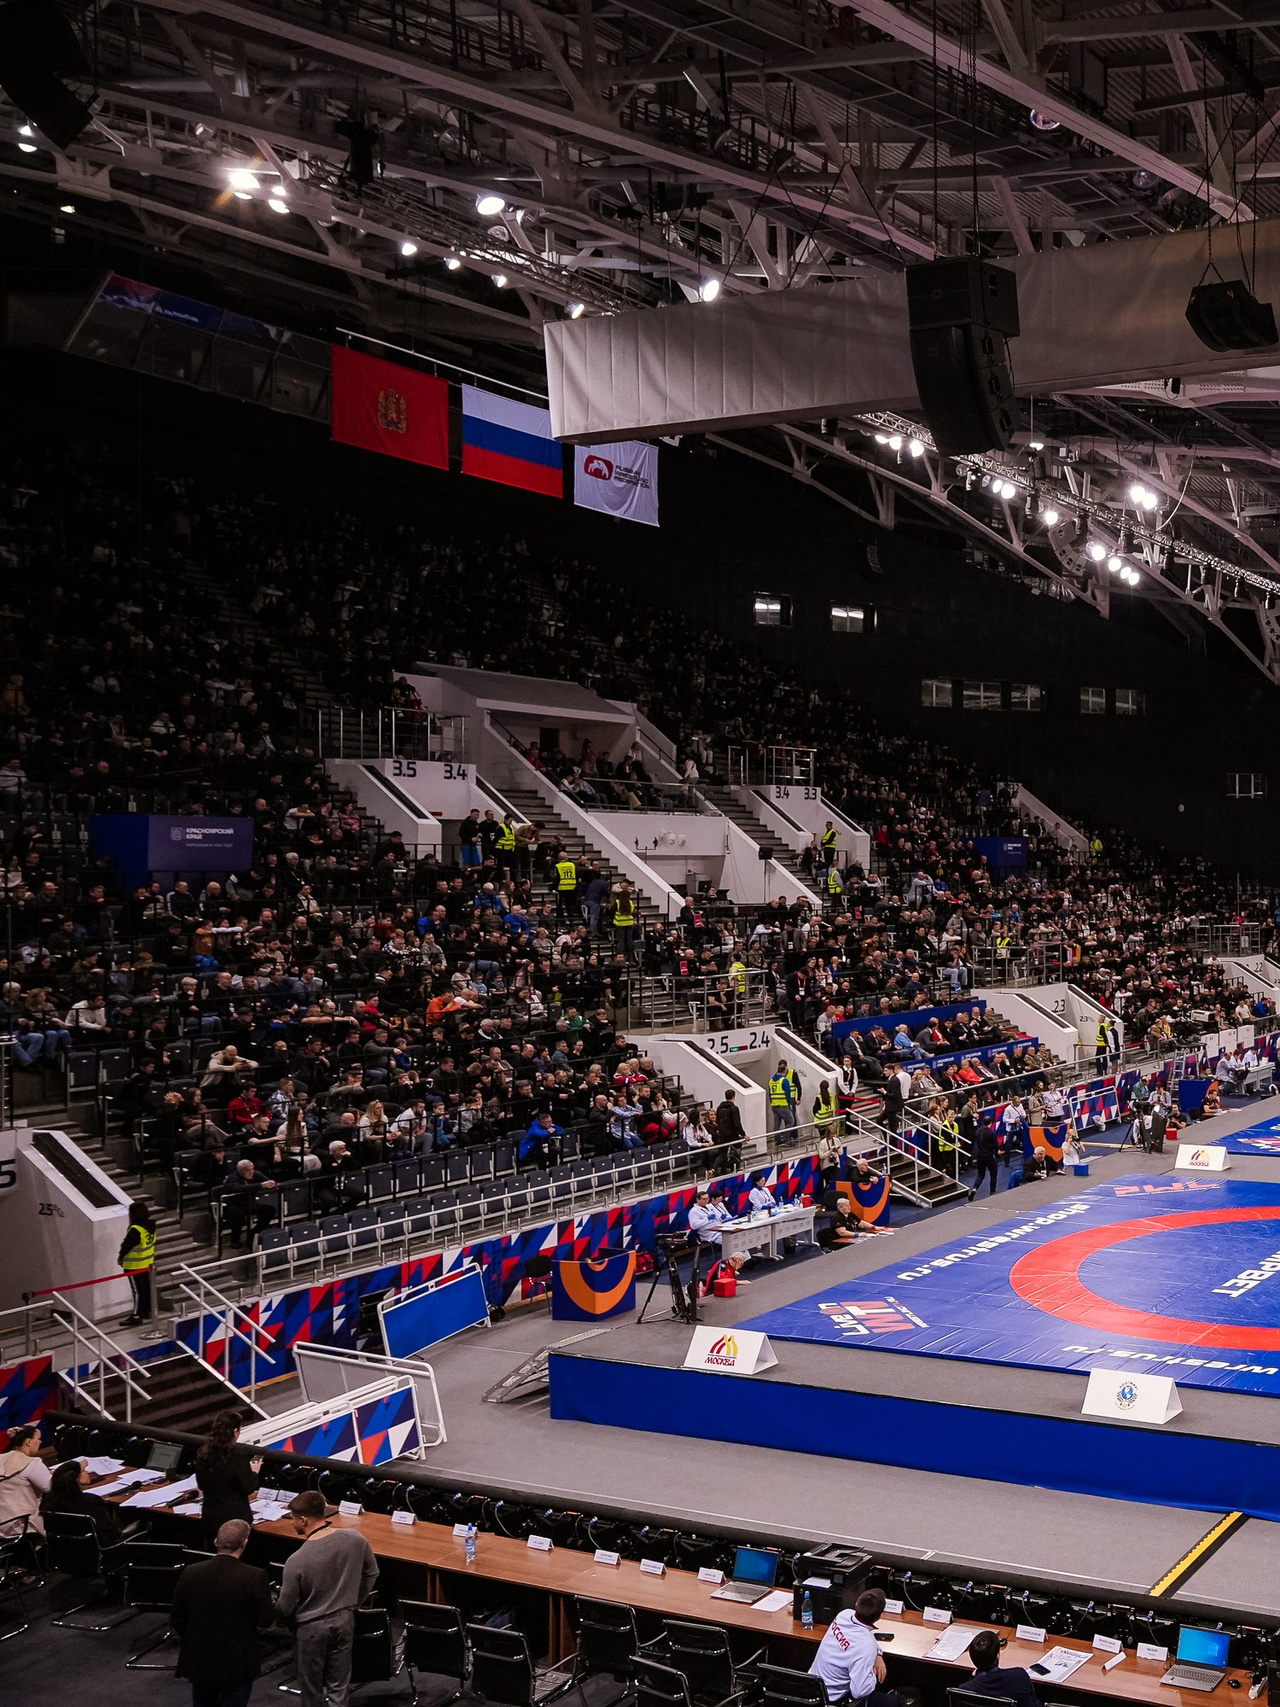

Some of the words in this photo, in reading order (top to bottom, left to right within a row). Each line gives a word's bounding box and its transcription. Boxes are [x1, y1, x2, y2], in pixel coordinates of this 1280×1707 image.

[393, 760, 417, 778] 3.5
[444, 764, 467, 780] 3.4
[775, 786, 790, 799] 3.4
[804, 787, 817, 800] 3.3
[749, 1031, 770, 1050] 2.4
[896, 1202, 1091, 1282] shop.wrestrus.ru
[704, 1356, 735, 1367] МОСКВА
[1061, 1345, 1280, 1376] wrestrus.ru
